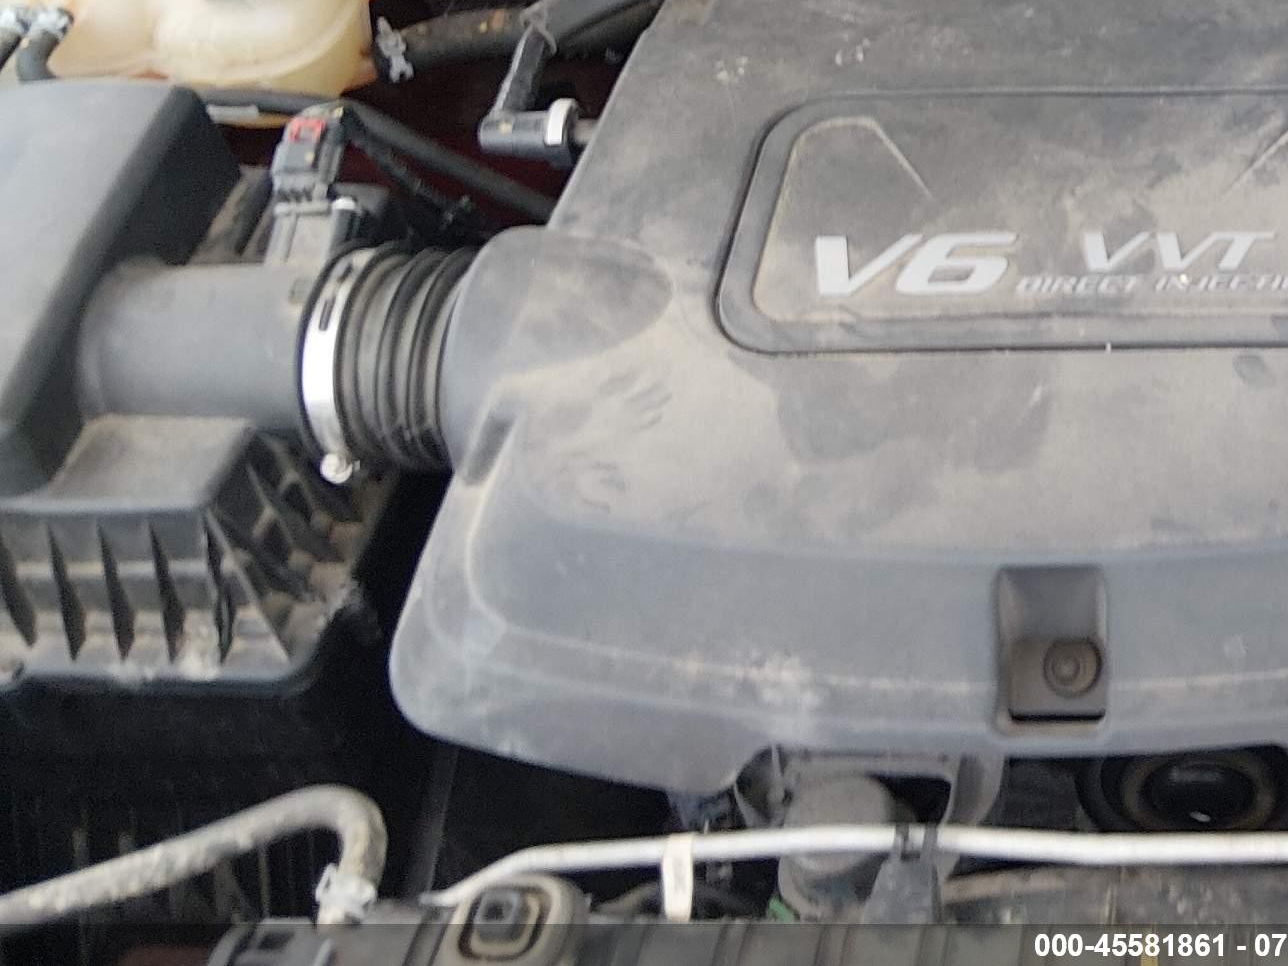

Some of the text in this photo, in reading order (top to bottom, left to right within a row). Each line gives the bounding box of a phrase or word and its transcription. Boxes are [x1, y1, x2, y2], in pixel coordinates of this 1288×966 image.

[814, 231, 1276, 296] V6 VVT
[1014, 271, 1139, 295] DIRECT
